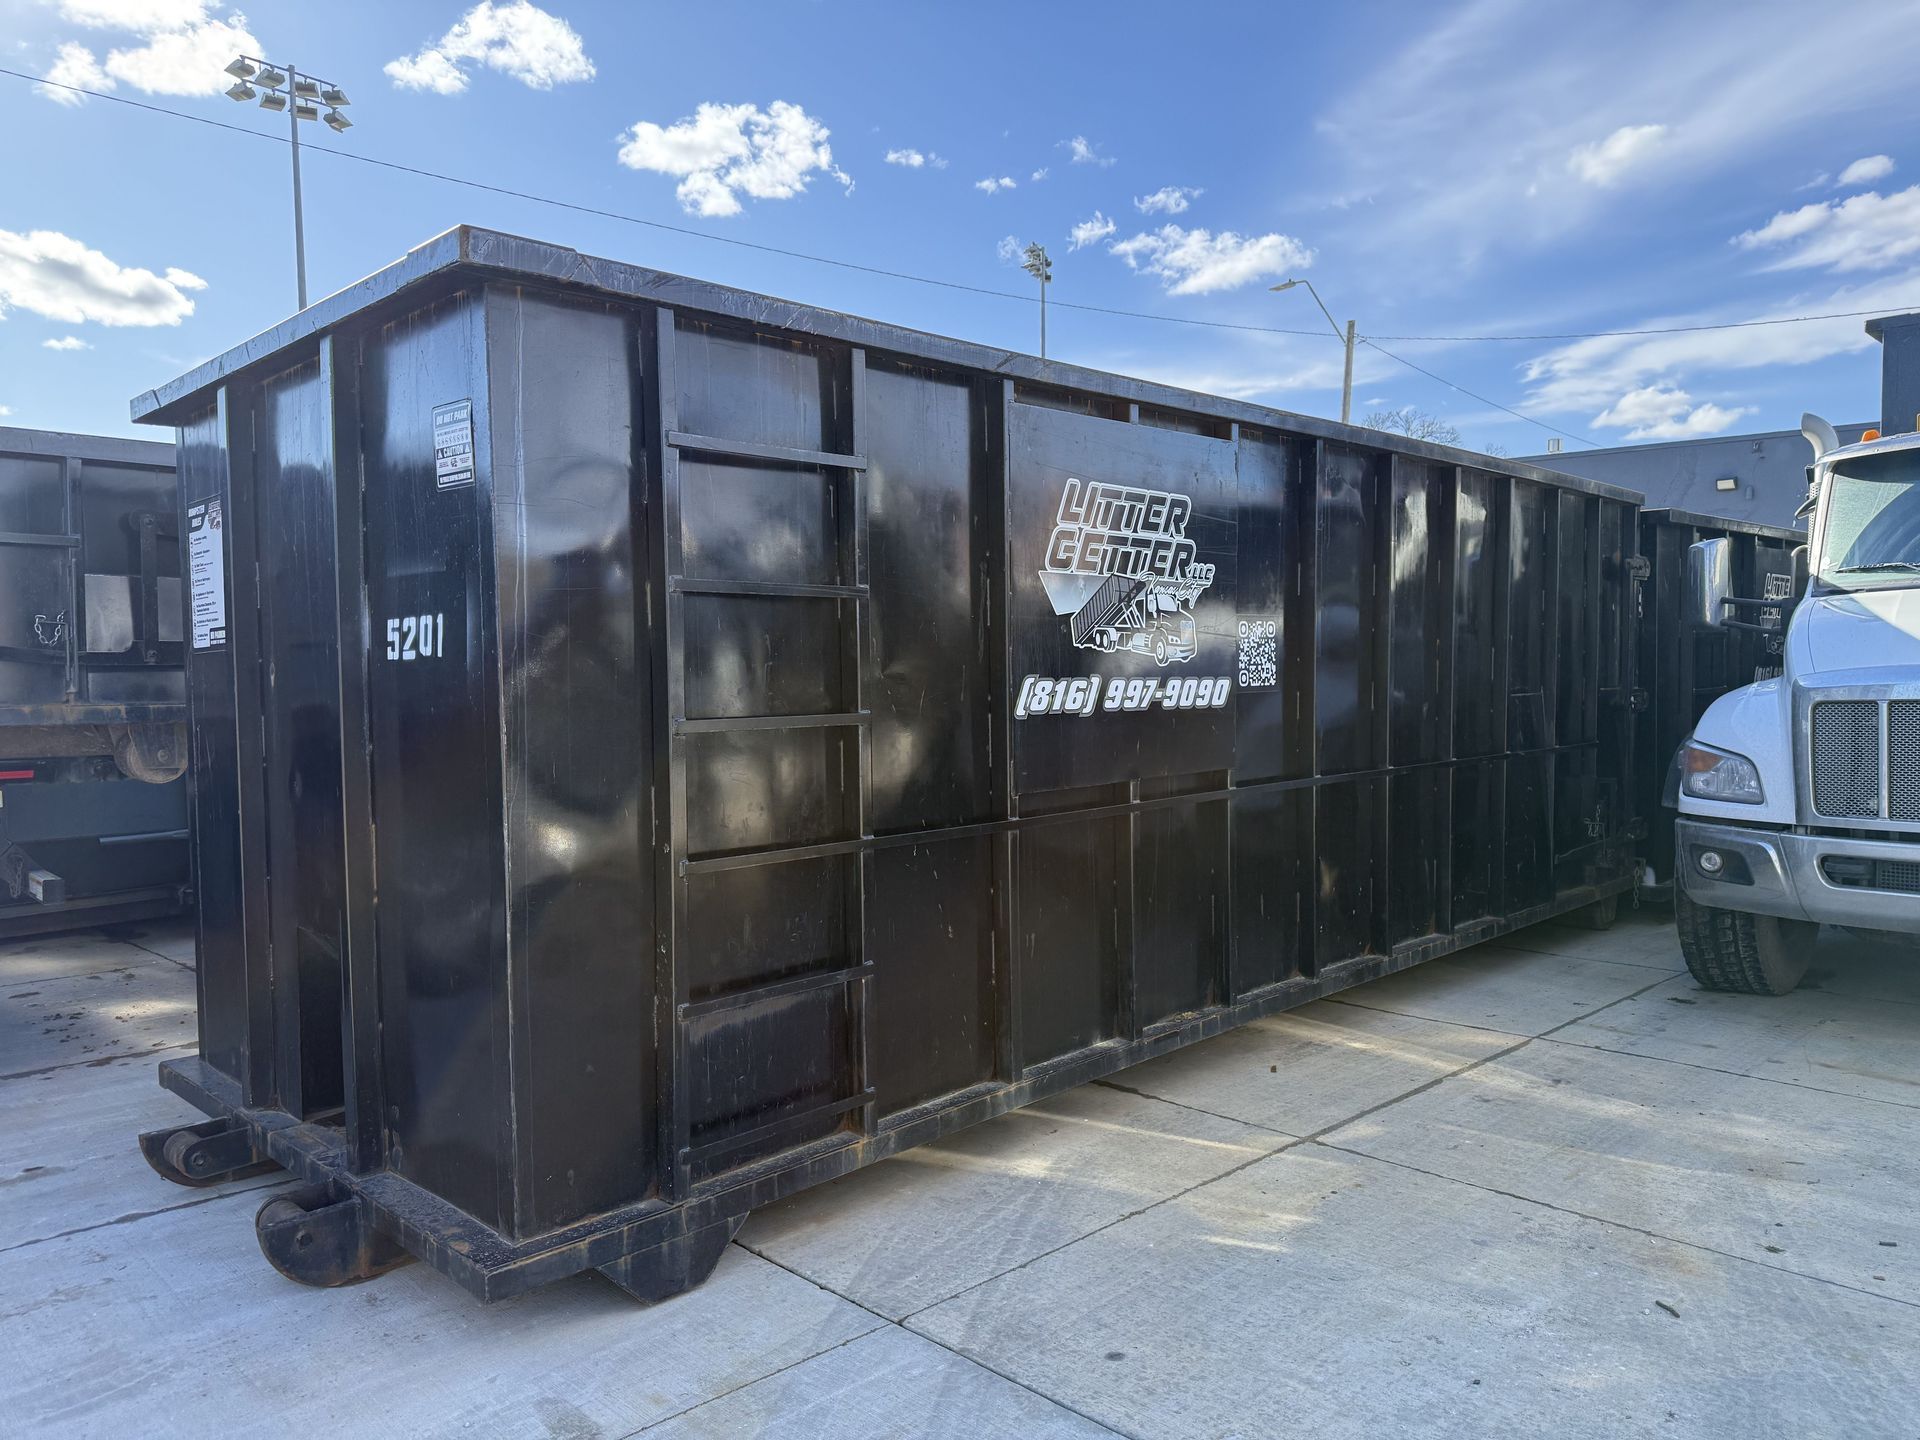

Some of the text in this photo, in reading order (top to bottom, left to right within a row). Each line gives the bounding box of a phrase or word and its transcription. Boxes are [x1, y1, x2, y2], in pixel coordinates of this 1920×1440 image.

[1056, 478, 1192, 538] LITTER
[1045, 526, 1197, 580] GETTER
[1190, 562, 1215, 582] LLC
[1177, 578, 1207, 609] City
[386, 613, 443, 660] 5201
[1014, 674, 1233, 719] (816) 997-9090
